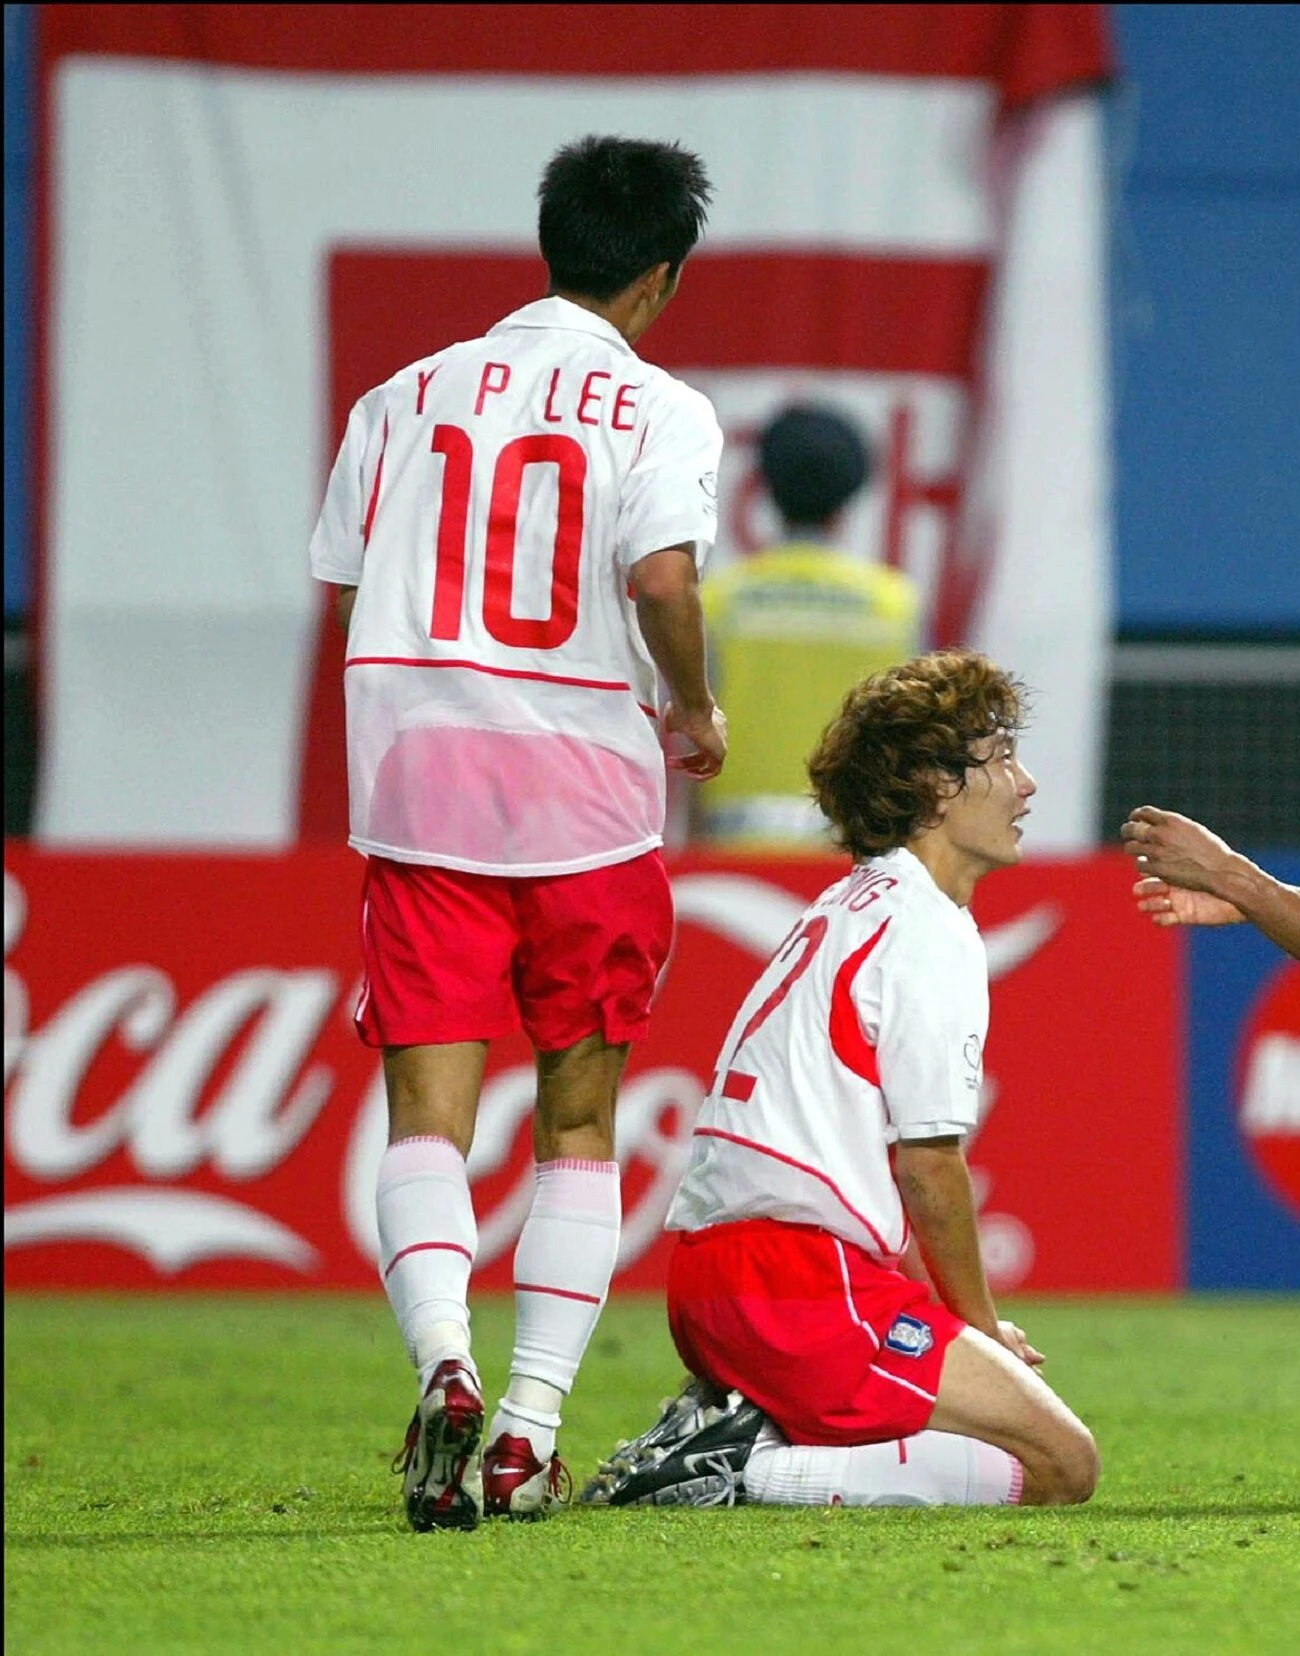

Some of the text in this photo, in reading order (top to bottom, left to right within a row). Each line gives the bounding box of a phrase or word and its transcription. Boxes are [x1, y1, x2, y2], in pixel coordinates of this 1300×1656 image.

[416, 362, 642, 431] Y P LEE
[430, 423, 588, 650] 10
[705, 914, 829, 1103] 2
